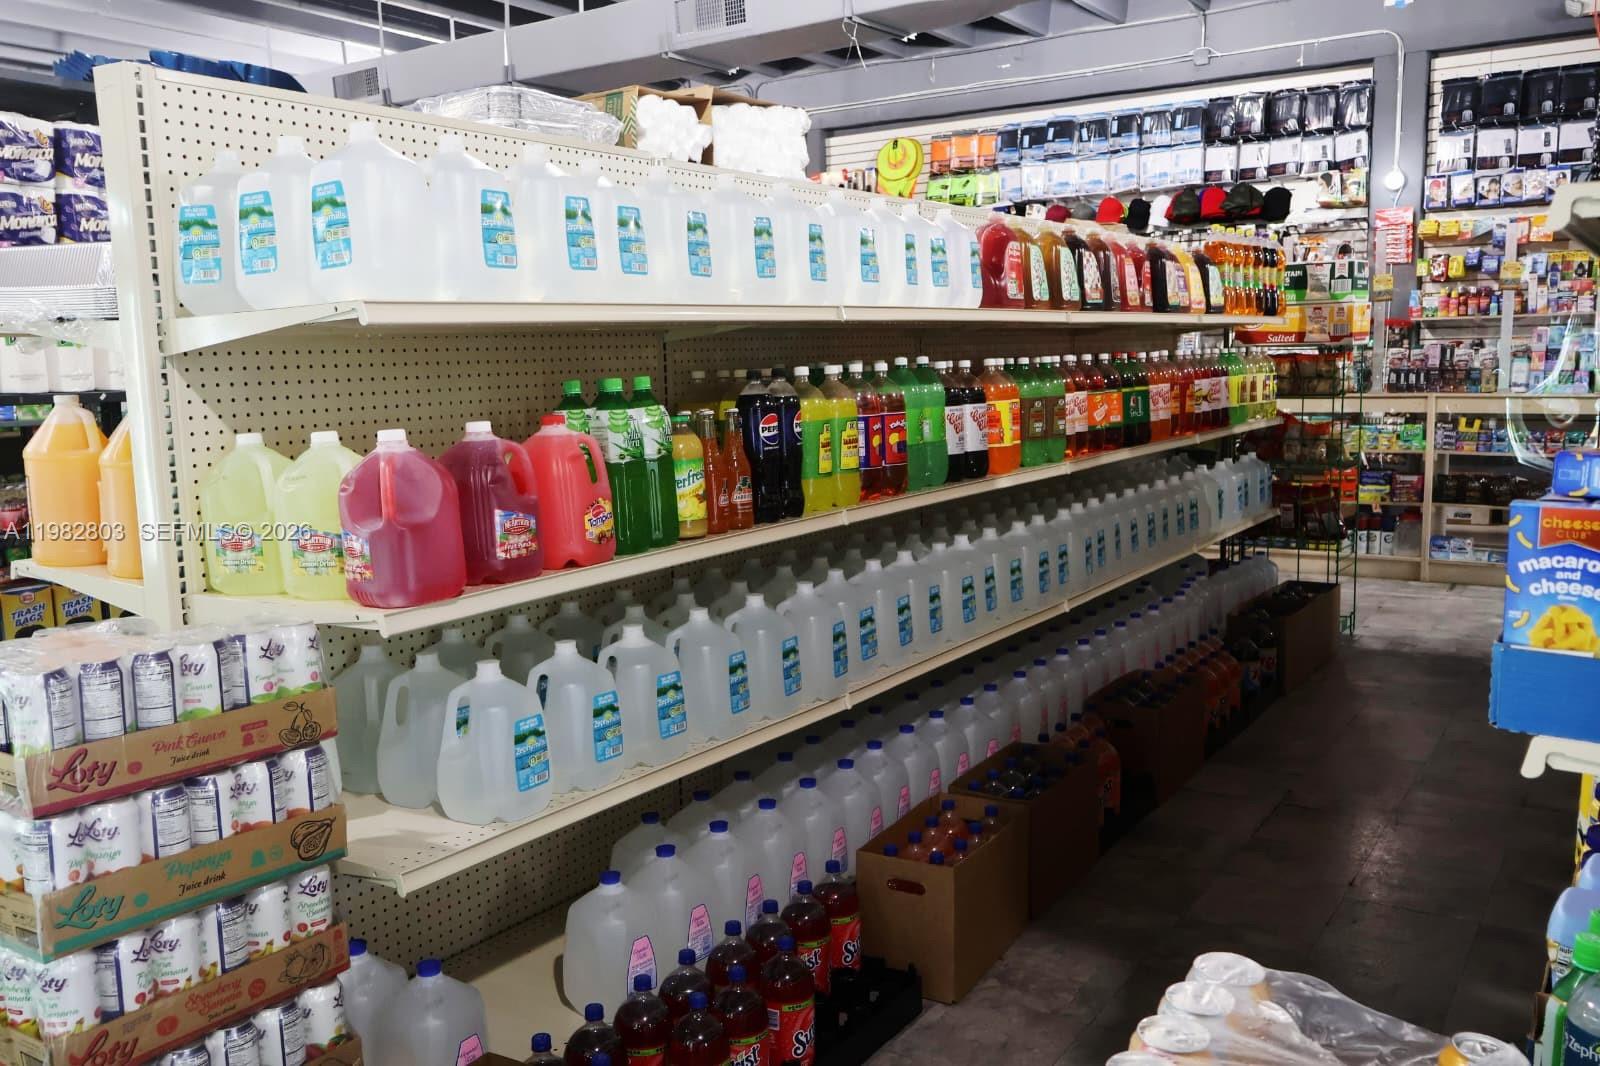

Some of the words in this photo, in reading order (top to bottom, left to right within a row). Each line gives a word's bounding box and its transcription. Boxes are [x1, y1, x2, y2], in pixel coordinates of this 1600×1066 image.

[1266, 334, 1296, 343] Salted
[1555, 570, 1581, 581] and
[11, 602, 45, 620] TRASH
[61, 595, 95, 611] TRASH
[65, 603, 92, 618] BAGS
[15, 611, 43, 628] BAGS
[152, 739, 184, 755] Pink
[185, 730, 227, 748] Guava
[47, 748, 118, 793] Loty
[83, 817, 119, 843] Loty
[178, 880, 202, 898] Juice
[203, 871, 227, 887] drink
[297, 877, 328, 897] Loty
[55, 884, 125, 930] Loty
